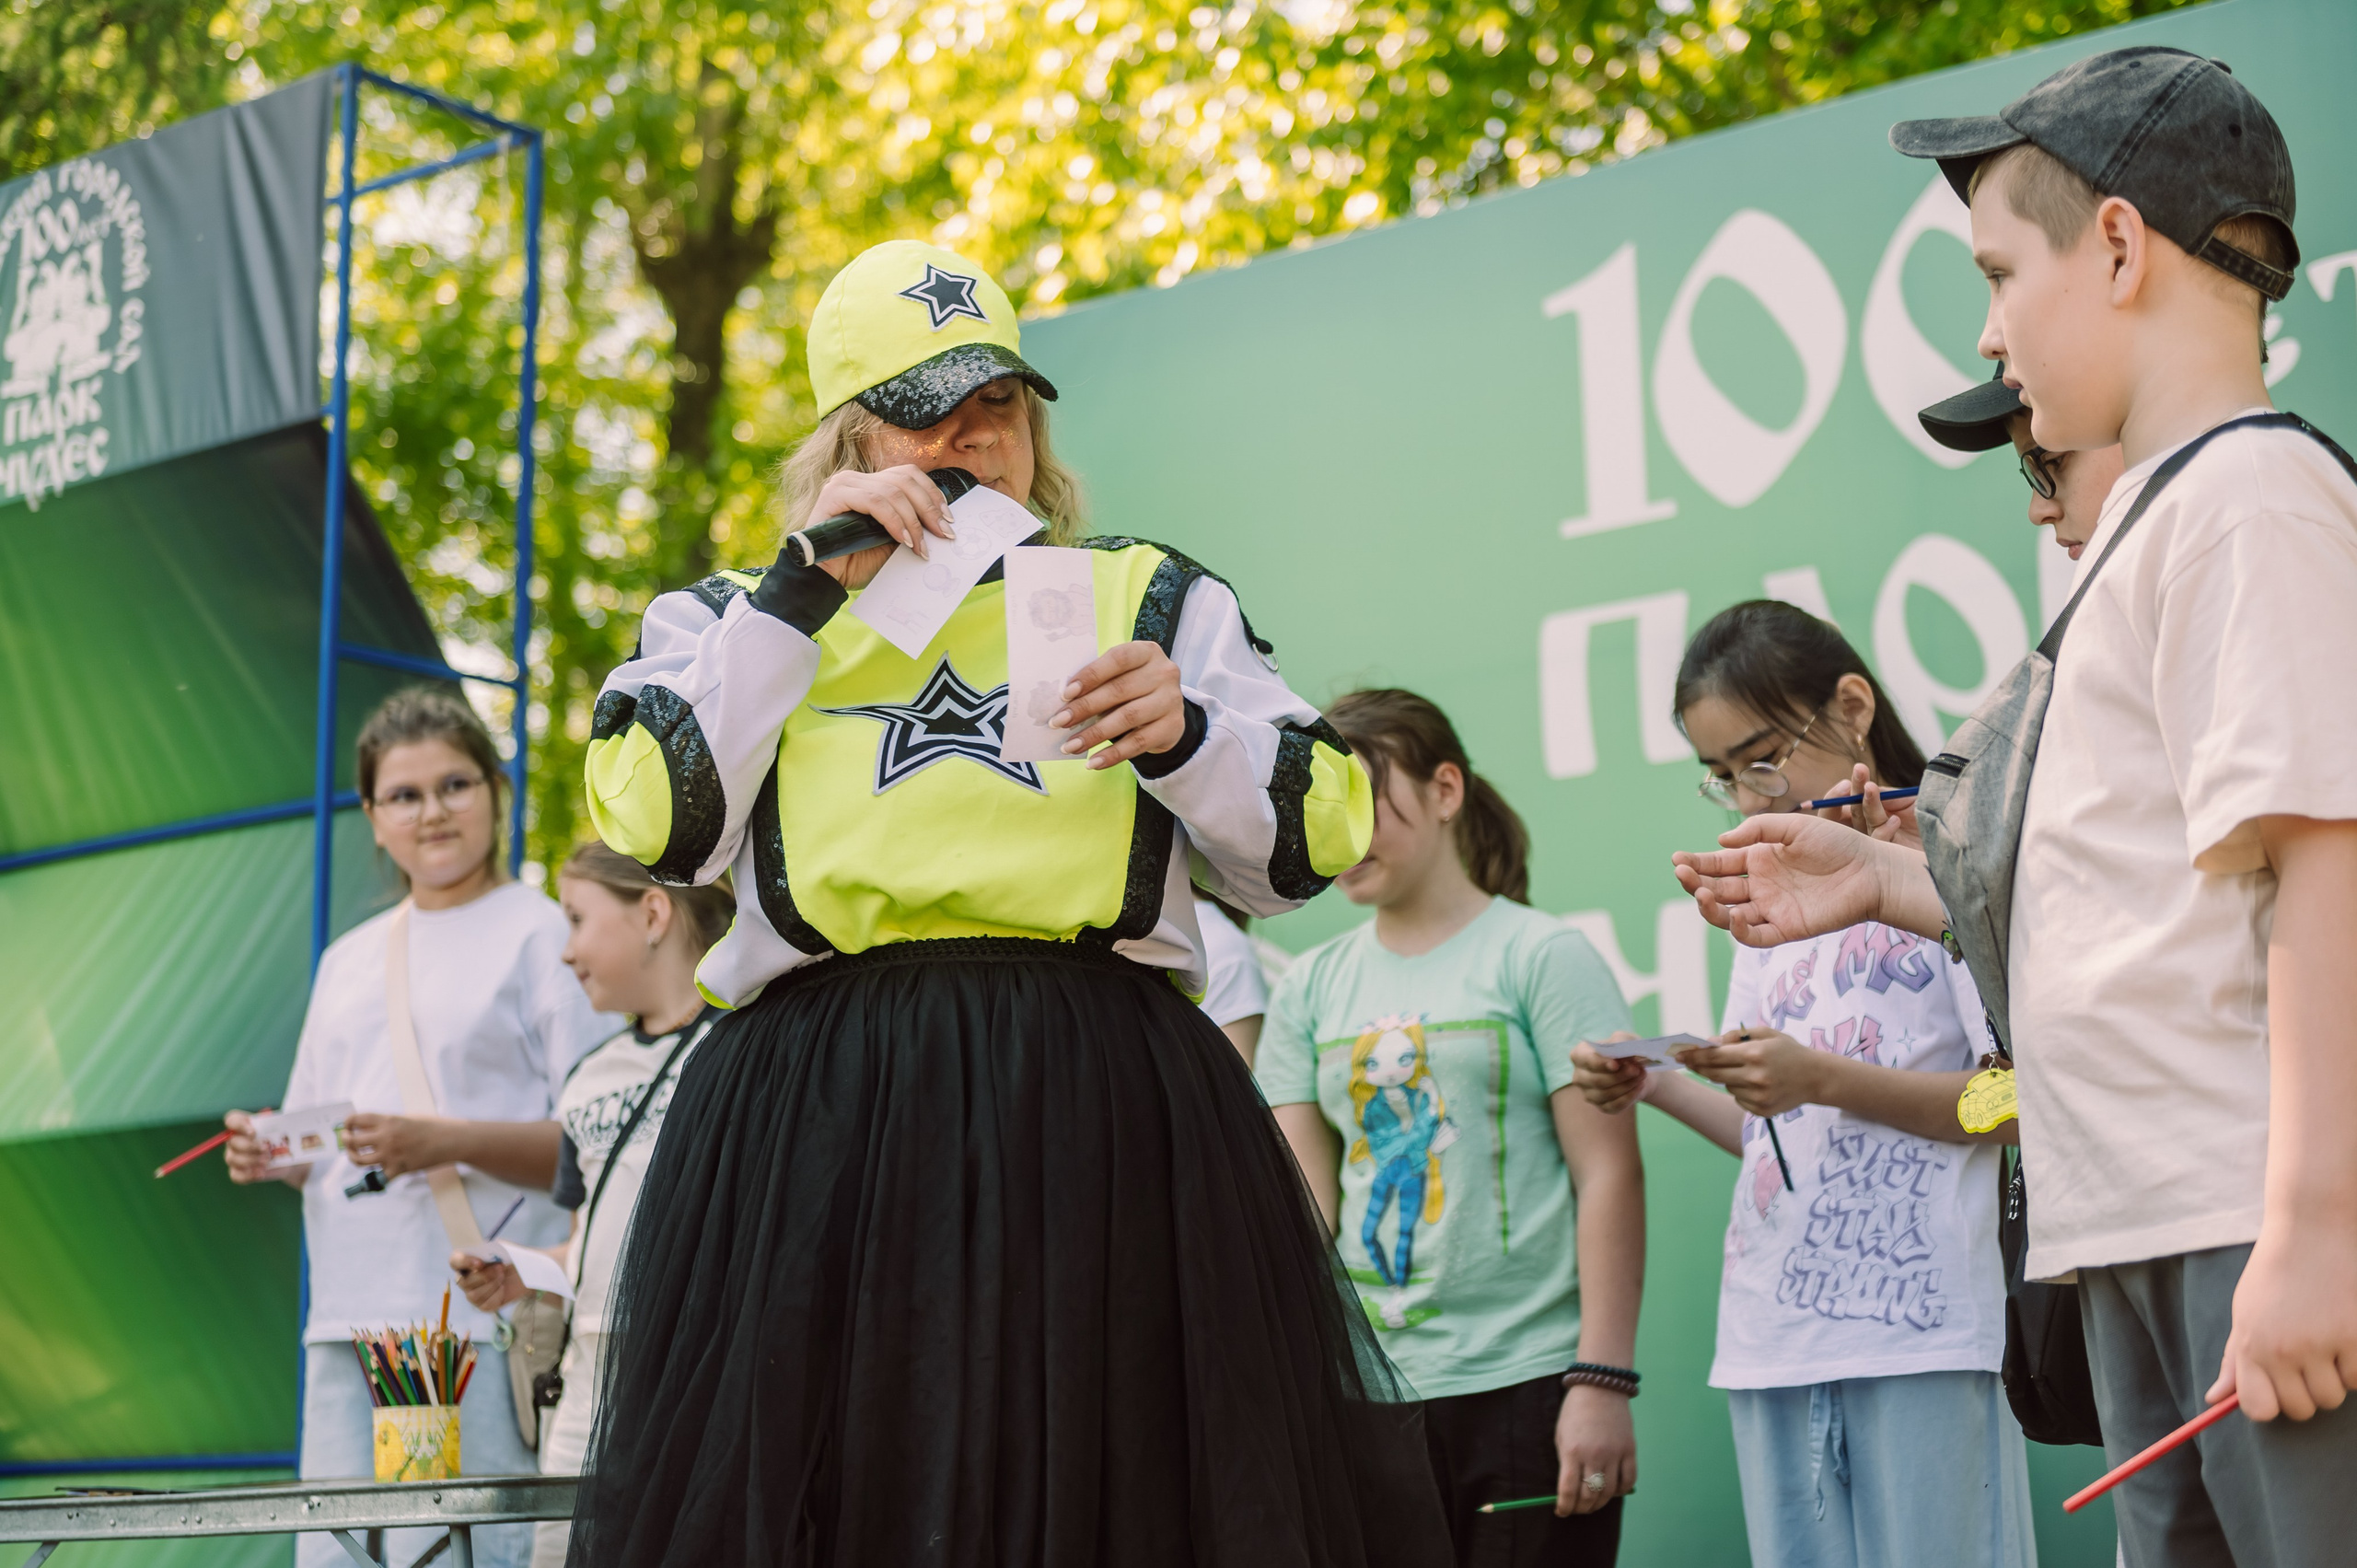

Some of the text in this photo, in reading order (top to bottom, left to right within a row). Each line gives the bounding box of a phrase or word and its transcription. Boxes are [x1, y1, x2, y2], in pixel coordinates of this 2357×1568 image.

[20, 196, 80, 269] 100
[1804, 1184, 1937, 1268] STAY
[1776, 1245, 1947, 1331] STRONG
